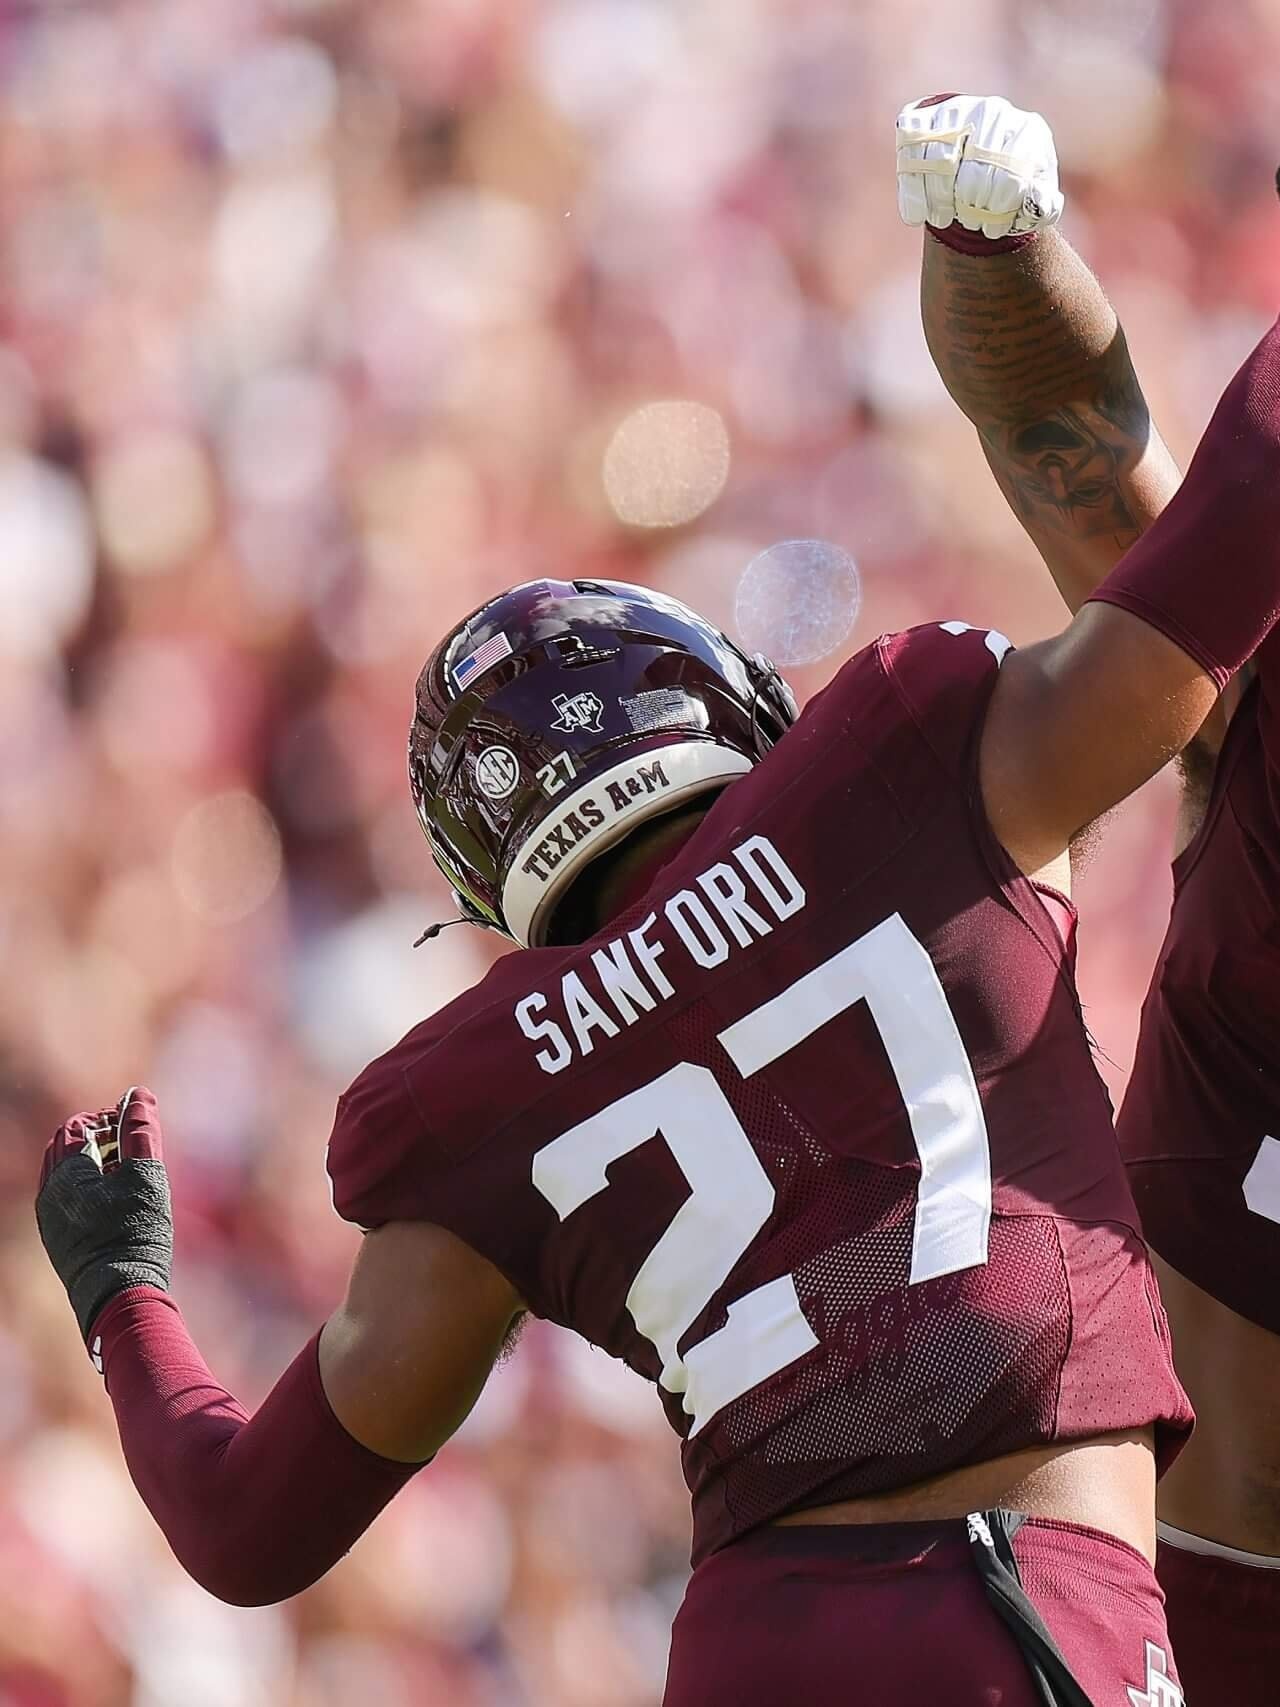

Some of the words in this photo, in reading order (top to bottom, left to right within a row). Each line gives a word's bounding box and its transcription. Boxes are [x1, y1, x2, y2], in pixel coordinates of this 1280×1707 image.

[480, 750, 515, 796] SEC
[521, 799, 605, 882] TEXAS
[604, 760, 670, 812] A&M
[536, 751, 577, 796] 27
[514, 834, 806, 1075] SANFORD
[531, 911, 993, 1441] 27
